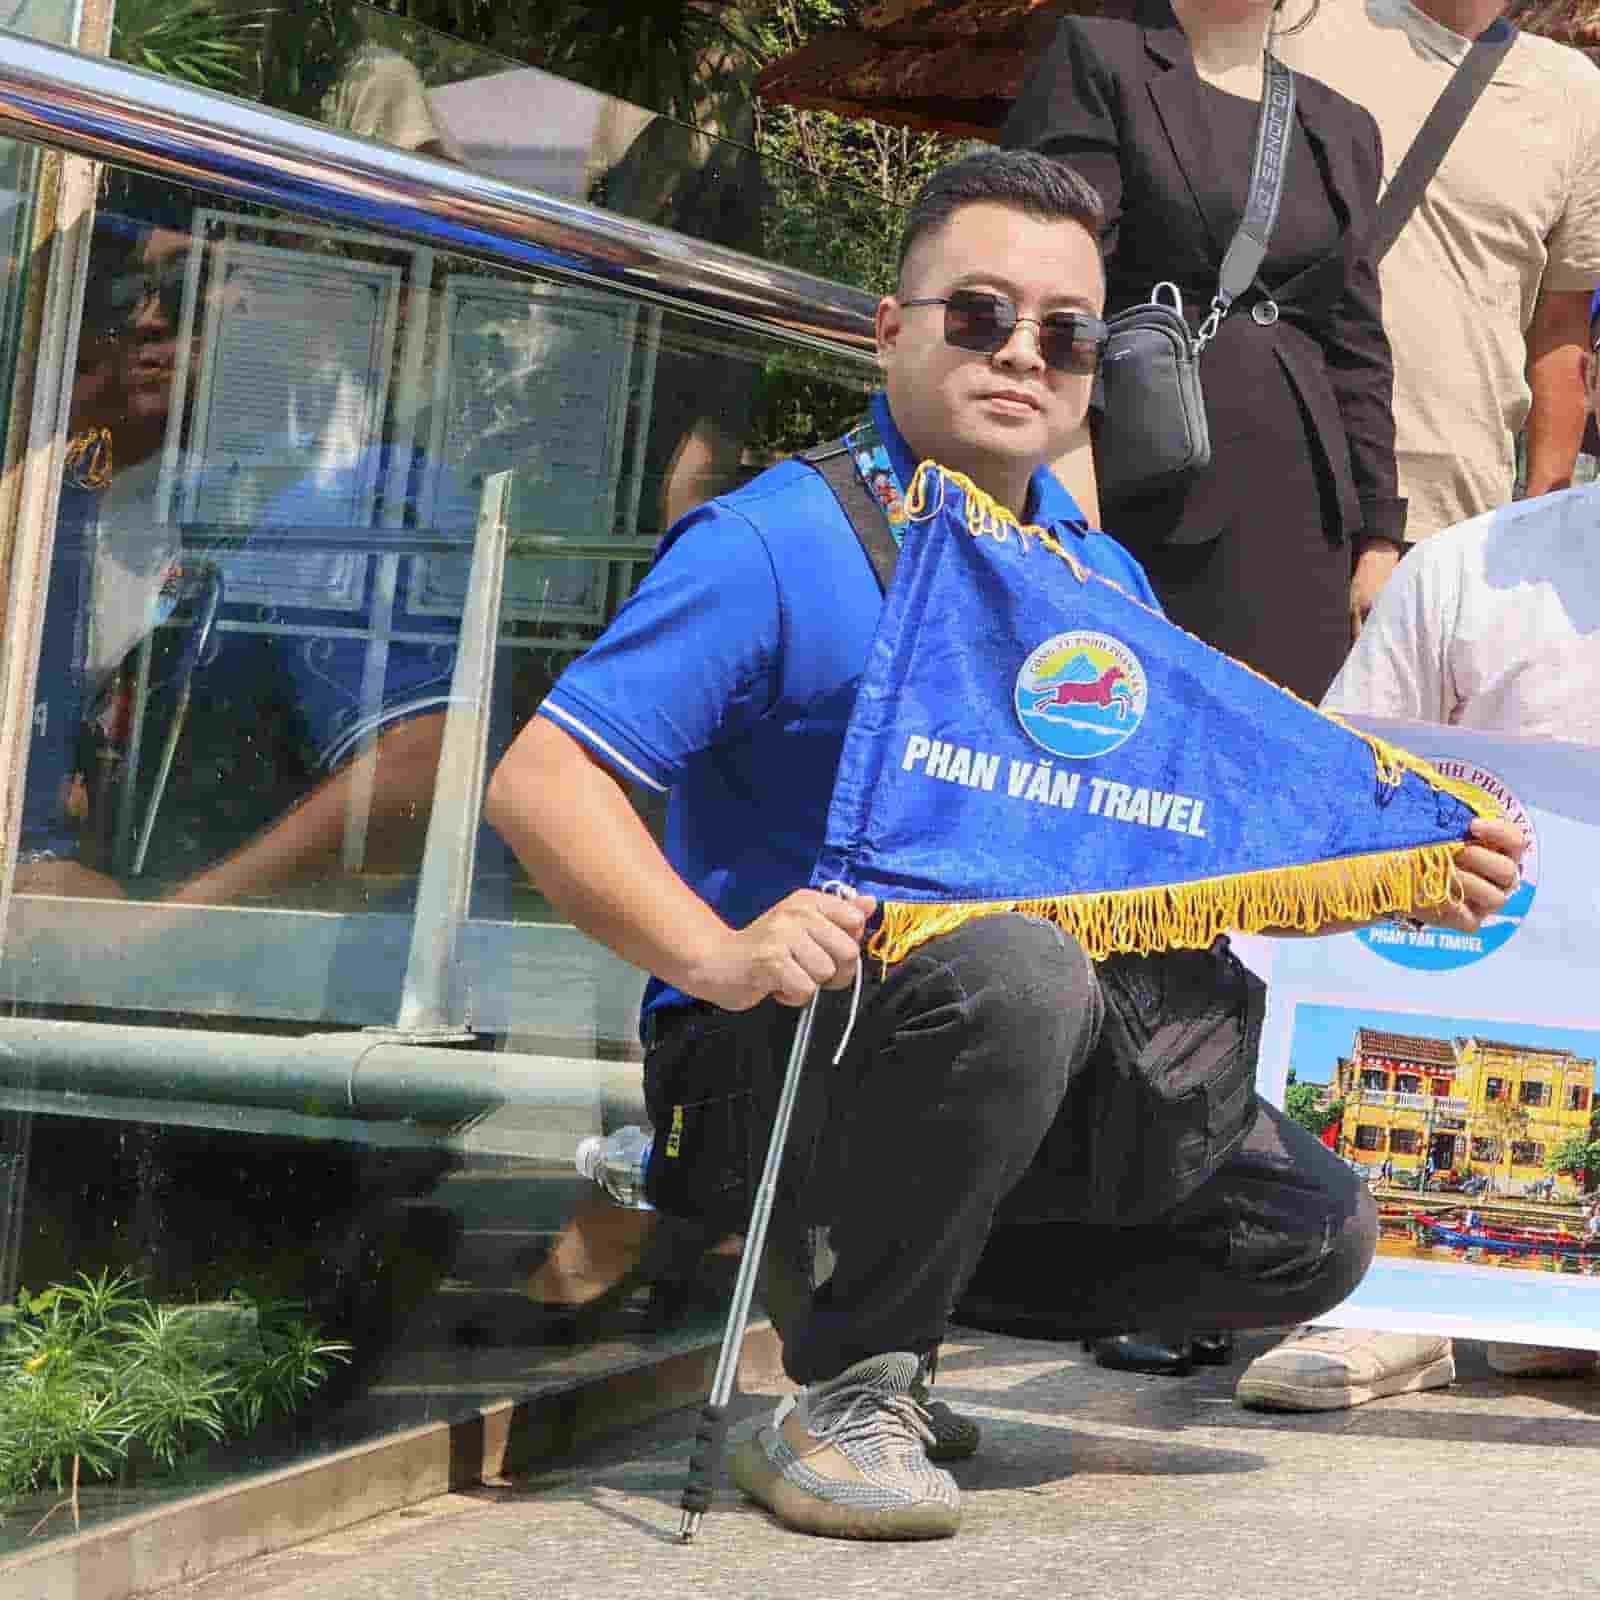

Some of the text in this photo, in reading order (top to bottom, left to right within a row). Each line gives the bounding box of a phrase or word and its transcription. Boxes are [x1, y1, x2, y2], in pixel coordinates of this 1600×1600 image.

[902, 734, 1207, 838] PHAN VĂN TRAVEL
